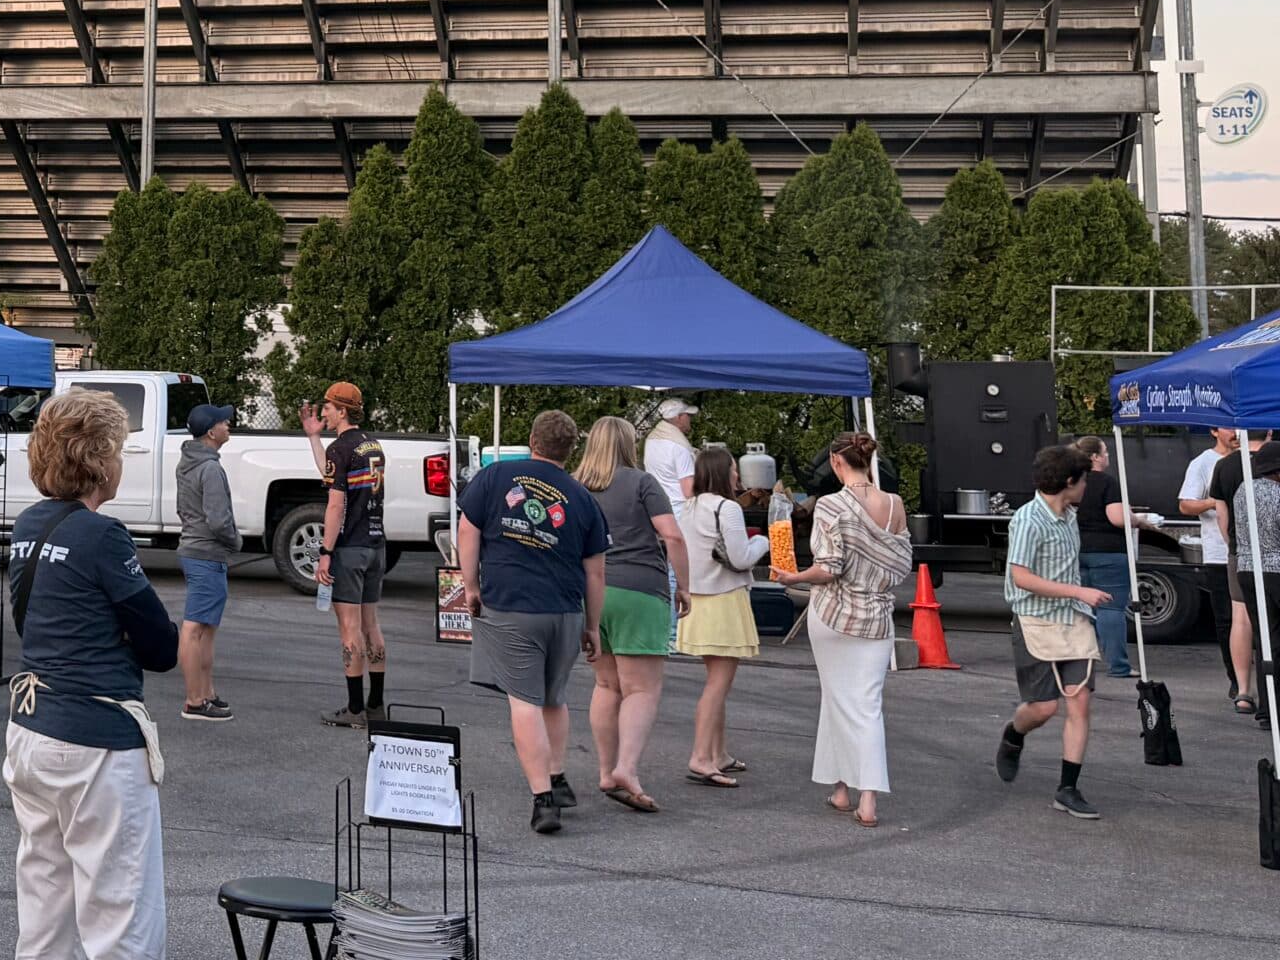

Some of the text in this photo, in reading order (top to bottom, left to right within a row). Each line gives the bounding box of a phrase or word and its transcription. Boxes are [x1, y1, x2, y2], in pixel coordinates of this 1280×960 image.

[1211, 106, 1254, 118] SEATS
[1218, 124, 1249, 136] 1-11
[1146, 384, 1165, 413] Cycling
[1167, 382, 1193, 413] Strength
[382, 743, 422, 757] T-TOWN
[378, 760, 449, 777] ANNIVERSARY
